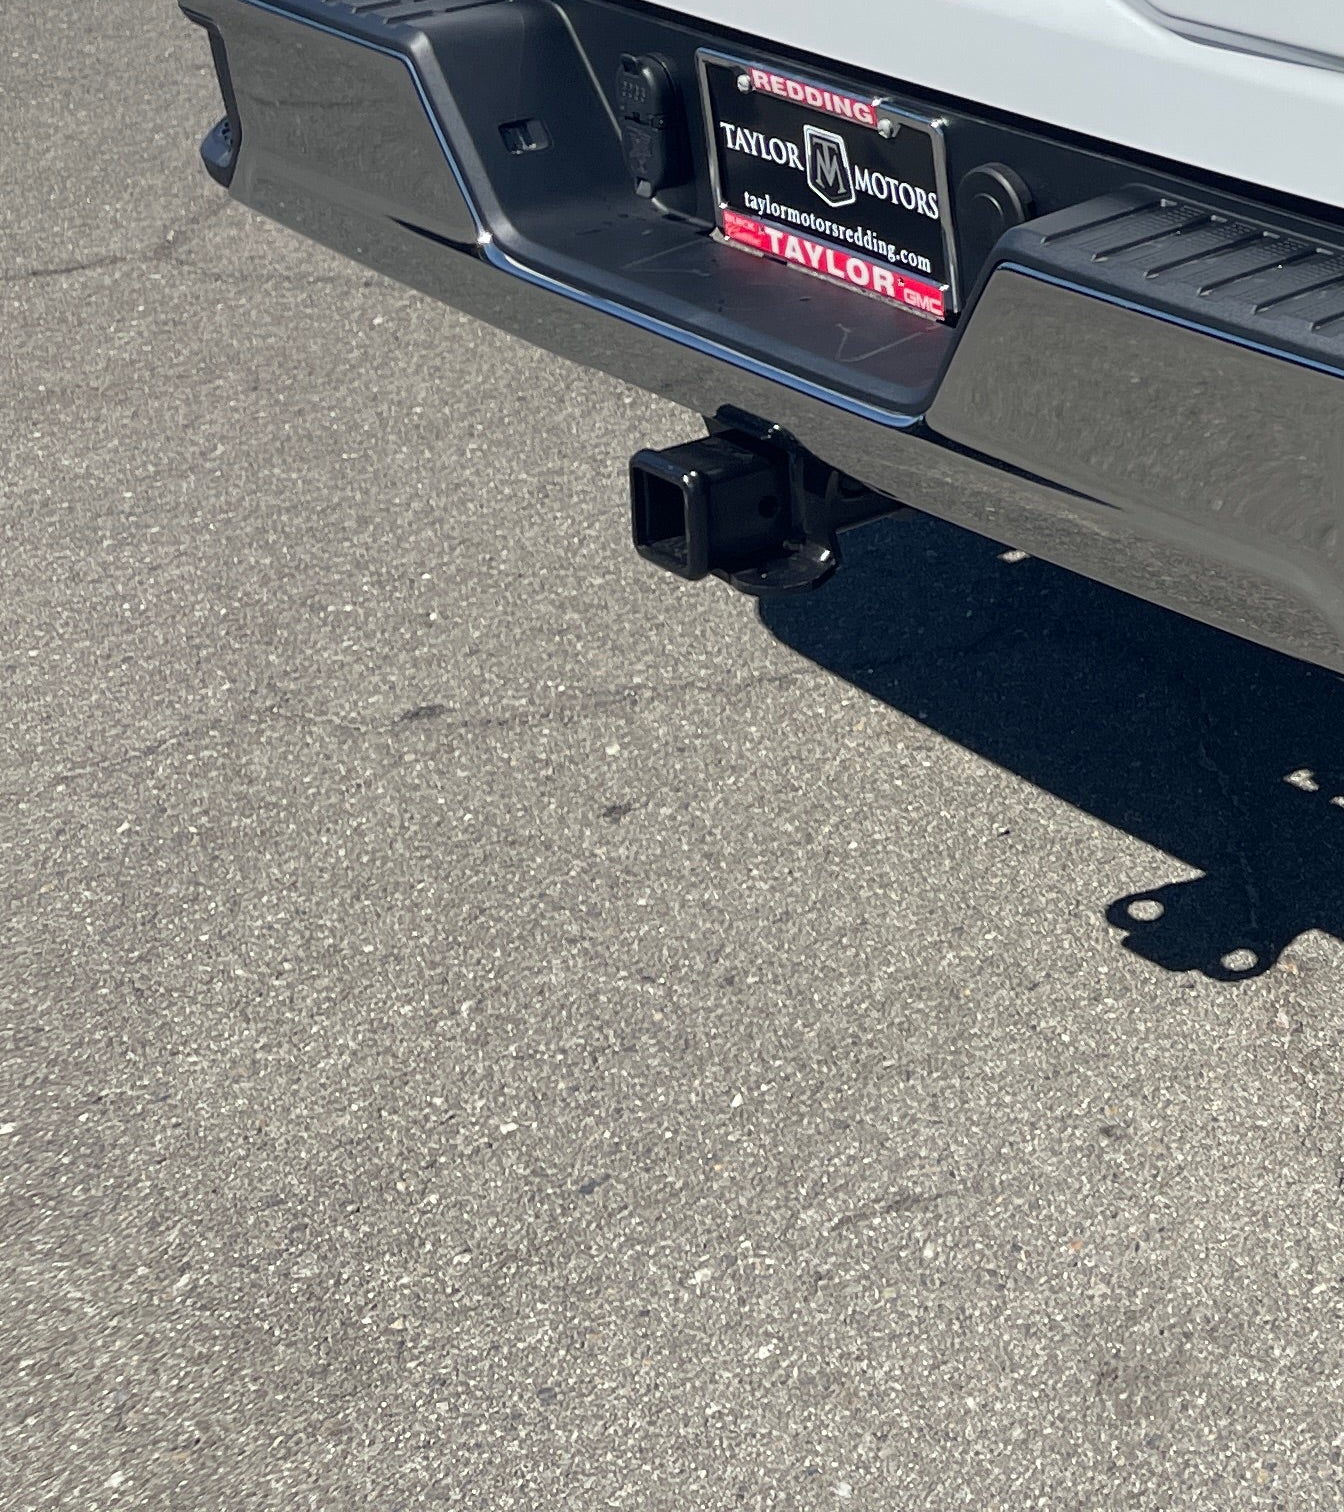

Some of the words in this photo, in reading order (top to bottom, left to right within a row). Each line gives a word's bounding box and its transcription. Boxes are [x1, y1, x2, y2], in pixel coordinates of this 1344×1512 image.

[752, 69, 874, 124] REDDING
[719, 121, 805, 172] TAYLOR
[854, 164, 940, 220] MOTORS
[743, 190, 932, 274] taylormotorsredding.com
[763, 226, 896, 298] TAYLOR
[903, 288, 943, 316] GMC
